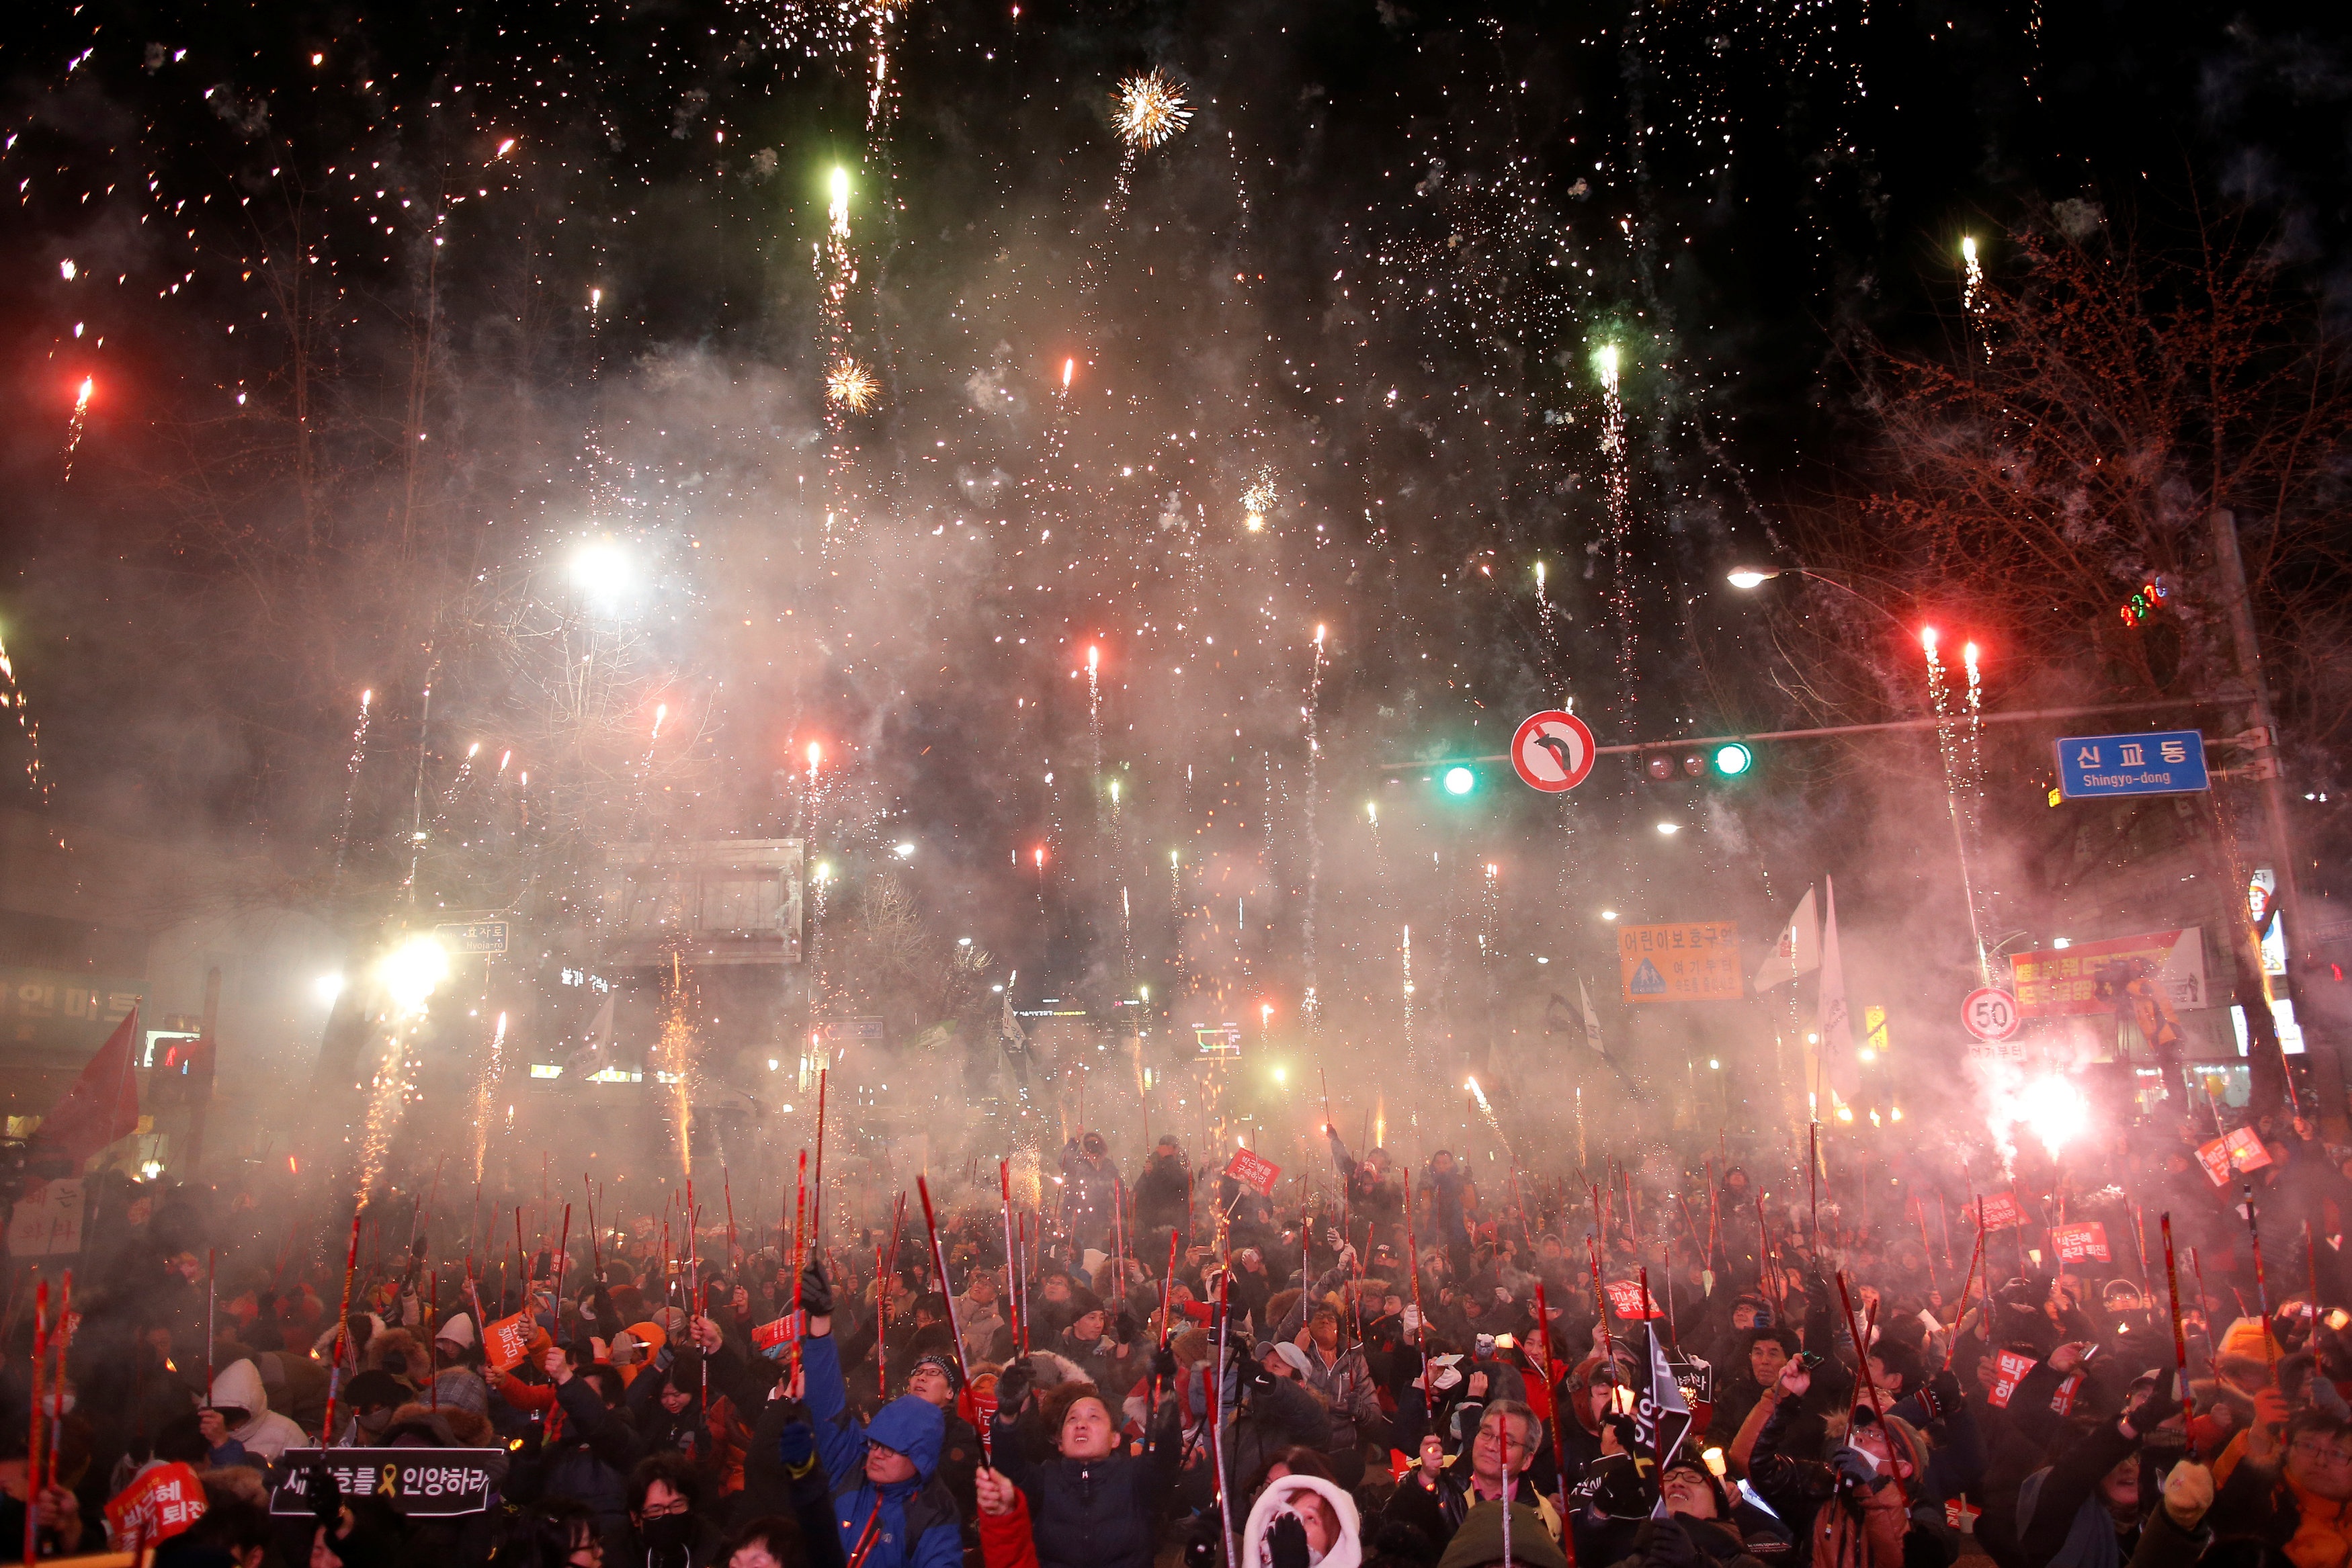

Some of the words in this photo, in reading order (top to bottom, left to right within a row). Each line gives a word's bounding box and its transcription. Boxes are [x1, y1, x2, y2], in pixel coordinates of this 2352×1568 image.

[2076, 740, 2186, 769] 신교동
[2083, 772, 2171, 787] Shingyo-dong
[466, 926, 503, 938] 효자로
[1625, 927, 1733, 952] 어린이보호구역
[466, 941, 503, 951] Hyoja-ro
[1674, 958, 1732, 975] 여기부터
[1976, 1001, 2007, 1028] 50
[1972, 1045, 2022, 1059] 여기부터
[1237, 1164, 1267, 1185] 구속하라
[1242, 1156, 1271, 1177] 박근혜를
[1593, 1275, 1603, 1304] CANDLE
[284, 1467, 376, 1495] 세호를
[403, 1467, 490, 1496] 인양하라
